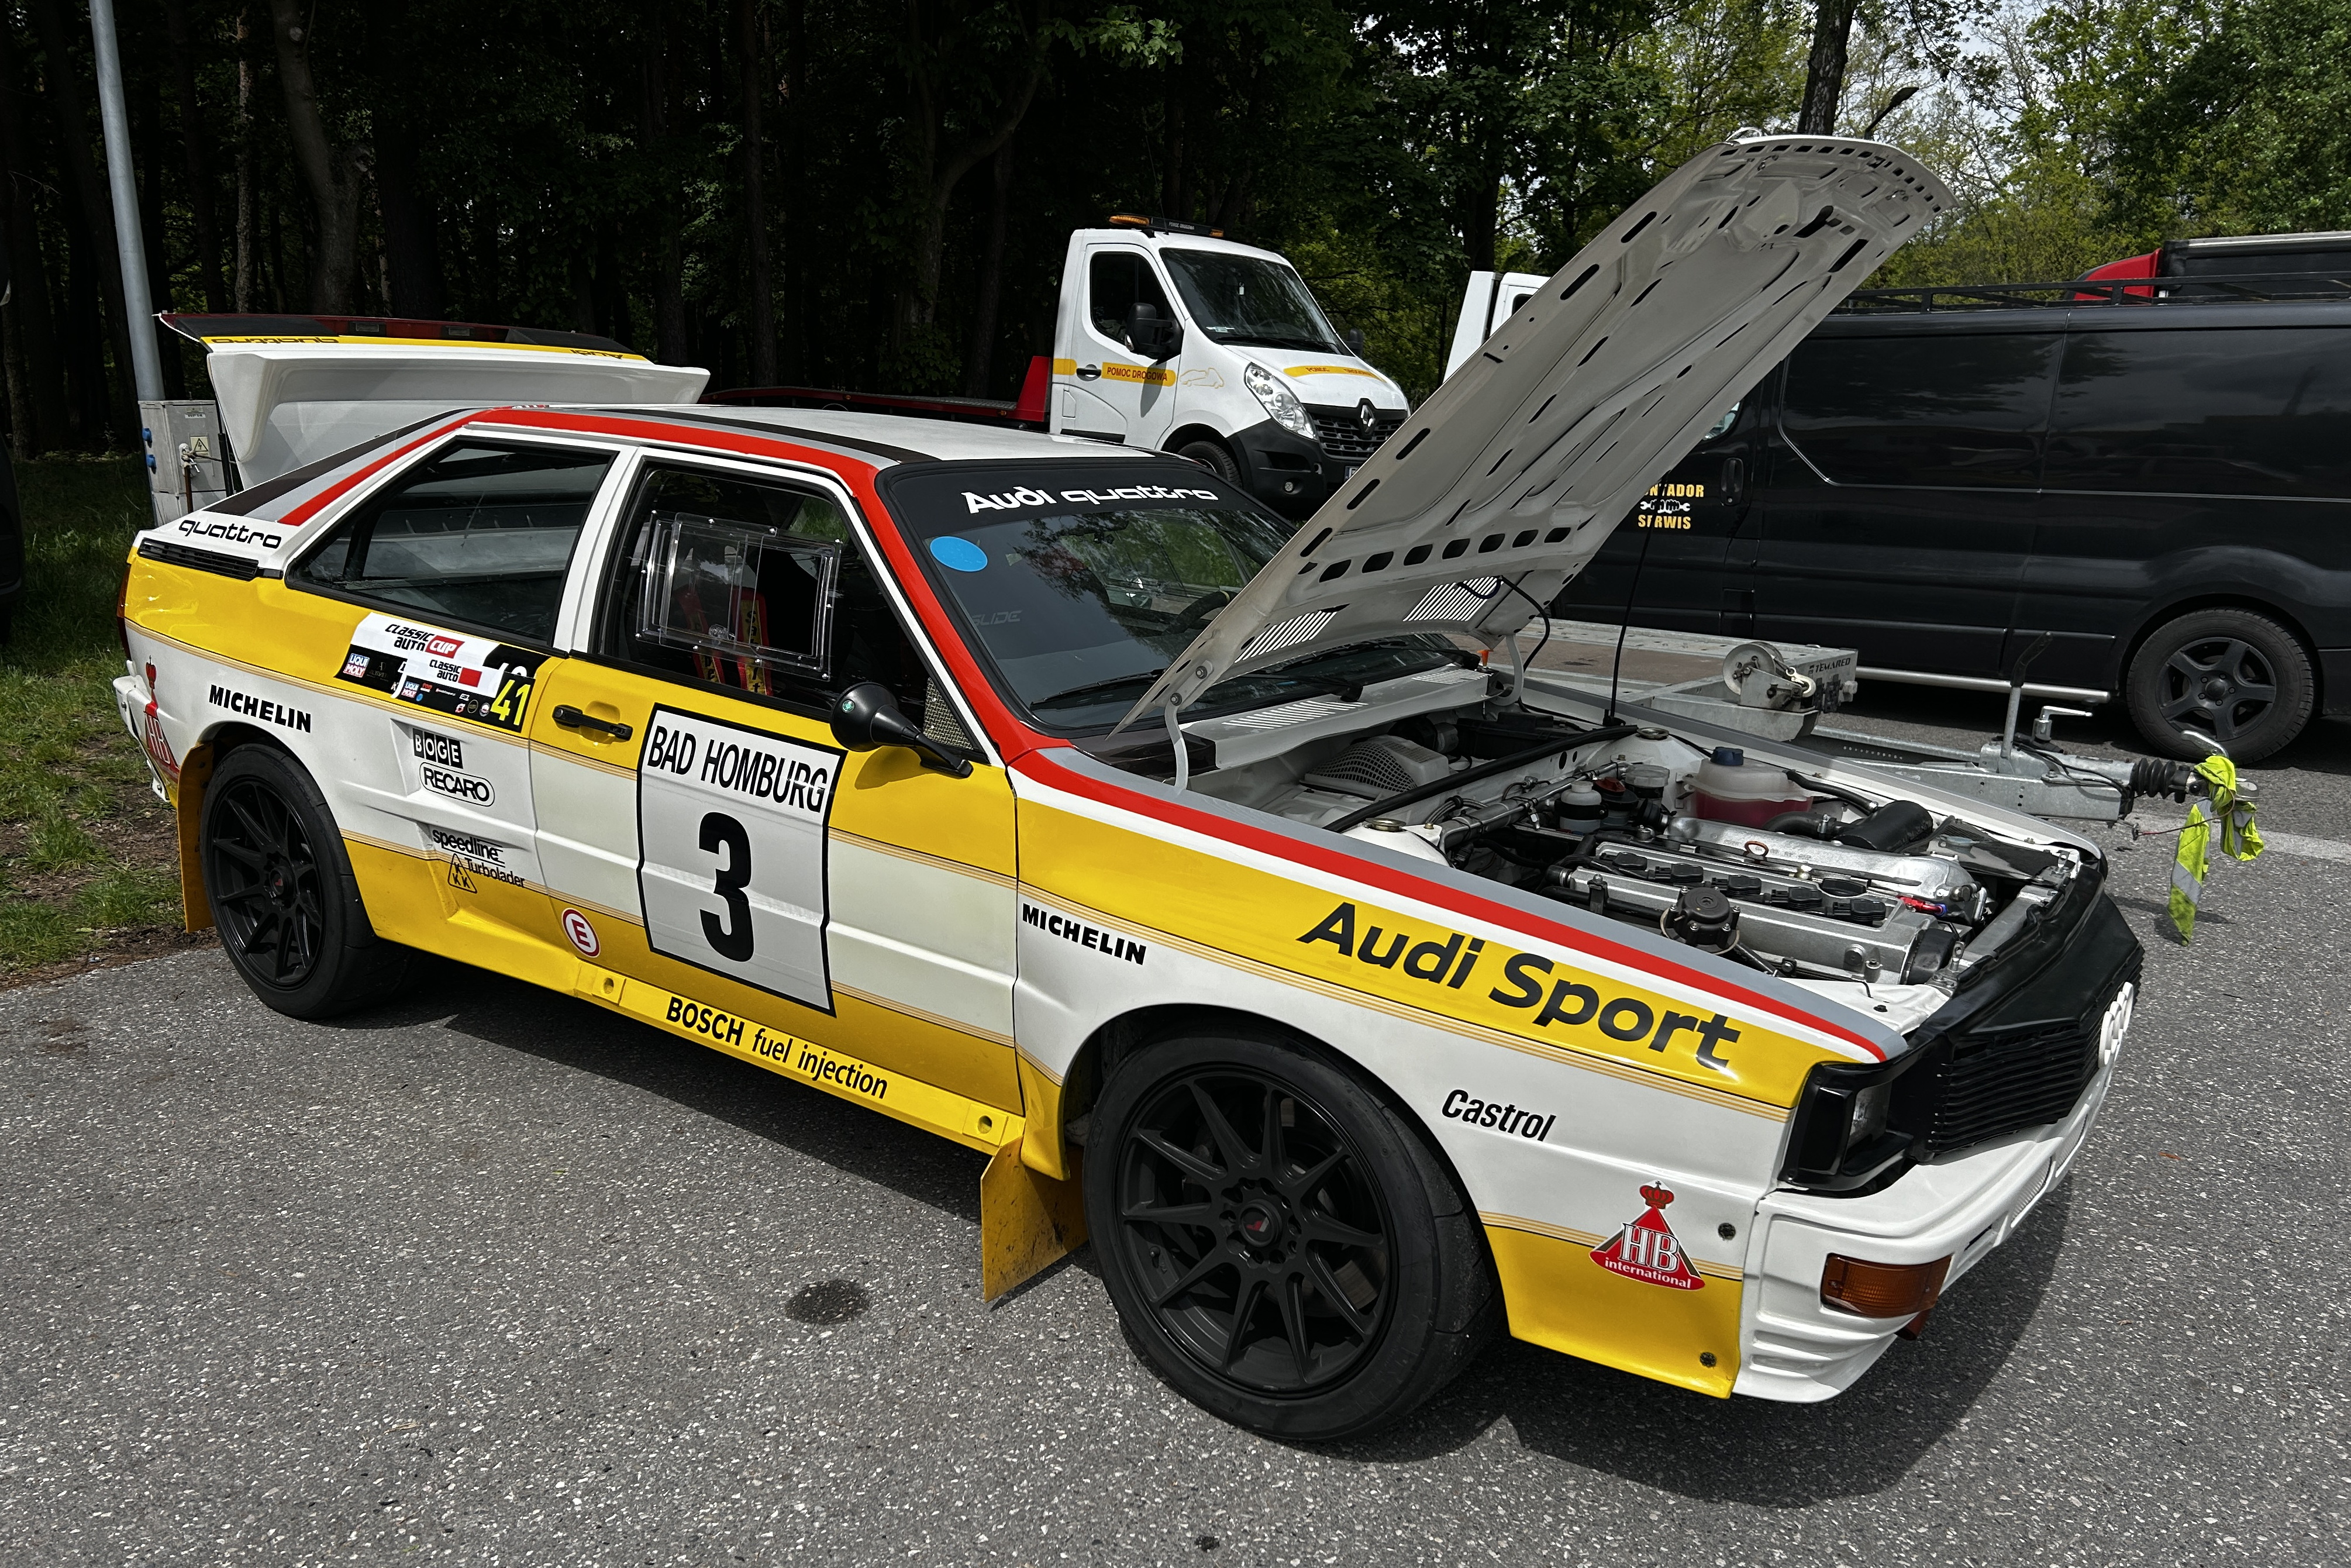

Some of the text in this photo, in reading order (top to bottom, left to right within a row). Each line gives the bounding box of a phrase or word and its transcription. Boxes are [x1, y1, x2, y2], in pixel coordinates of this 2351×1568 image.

[1107, 367, 1167, 381] POMOC DROGOWA
[961, 485, 1219, 514] Audi quattro
[178, 519, 282, 549] quattro
[349, 653, 370, 668] LIQUI
[428, 639, 457, 654] CUP
[343, 663, 368, 677] MOLY
[1815, 657, 1850, 673] TEMARED
[209, 684, 312, 733] MICHELIN
[490, 679, 531, 726] 41
[415, 734, 460, 763] BOGE
[423, 766, 489, 802] RECARO
[647, 725, 829, 813] BAD HOMBURG
[433, 829, 502, 863] speedline
[464, 857, 525, 888] Turbolader
[698, 812, 754, 963] 3
[571, 918, 591, 949] E
[1022, 902, 1147, 966] MICHELIN
[1297, 902, 1741, 1069] Audi Sport
[666, 996, 888, 1100] BOSCH fuel injection
[1442, 1088, 1557, 1142] Castrol
[1617, 1222, 1680, 1273] HB
[1604, 1257, 1692, 1289] international
